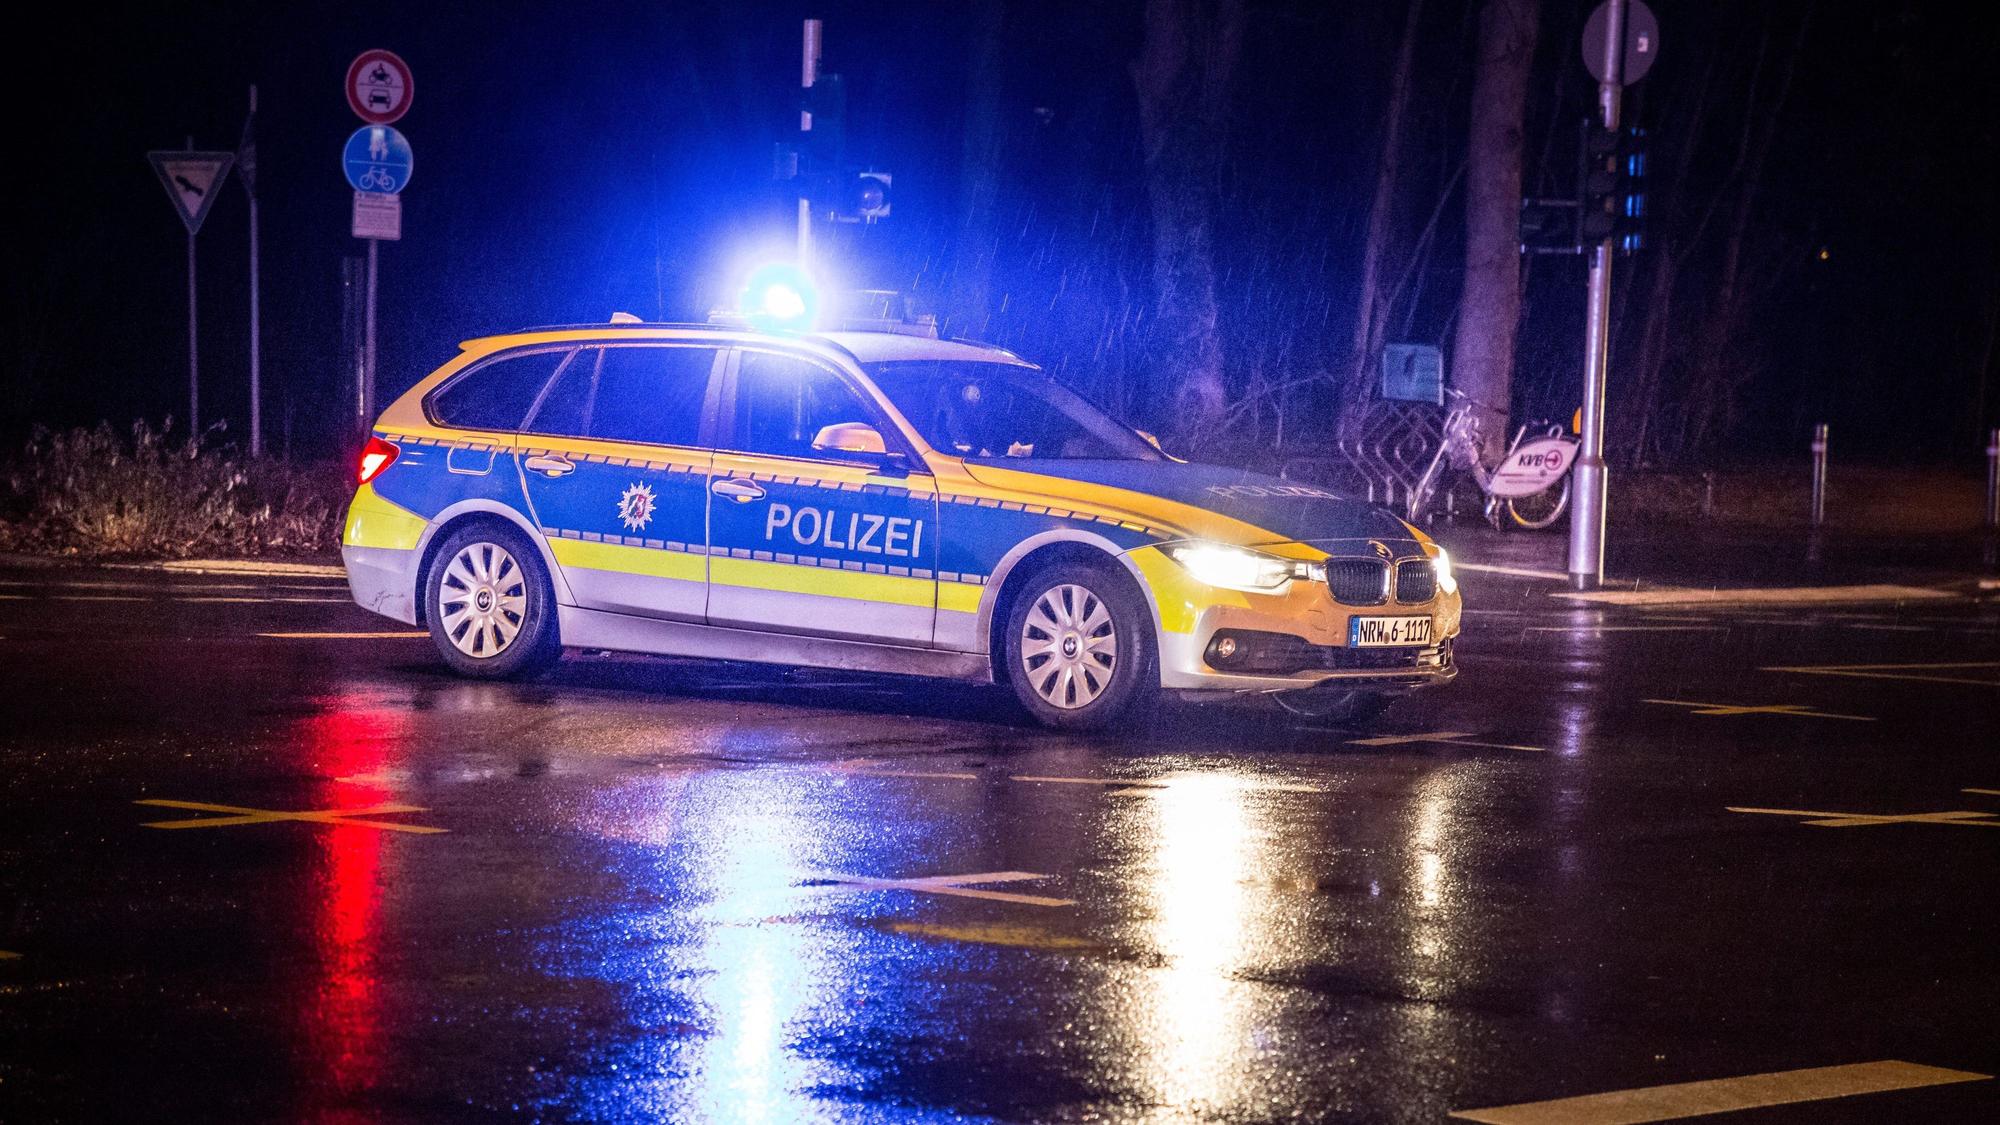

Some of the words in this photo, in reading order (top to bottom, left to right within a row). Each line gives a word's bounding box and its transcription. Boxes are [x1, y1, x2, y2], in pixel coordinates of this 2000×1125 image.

[1518, 454, 1545, 466] KVB
[765, 503, 923, 558] POLIZEI
[1359, 620, 1385, 642] NRW
[1391, 619, 1431, 642] 6-1117
